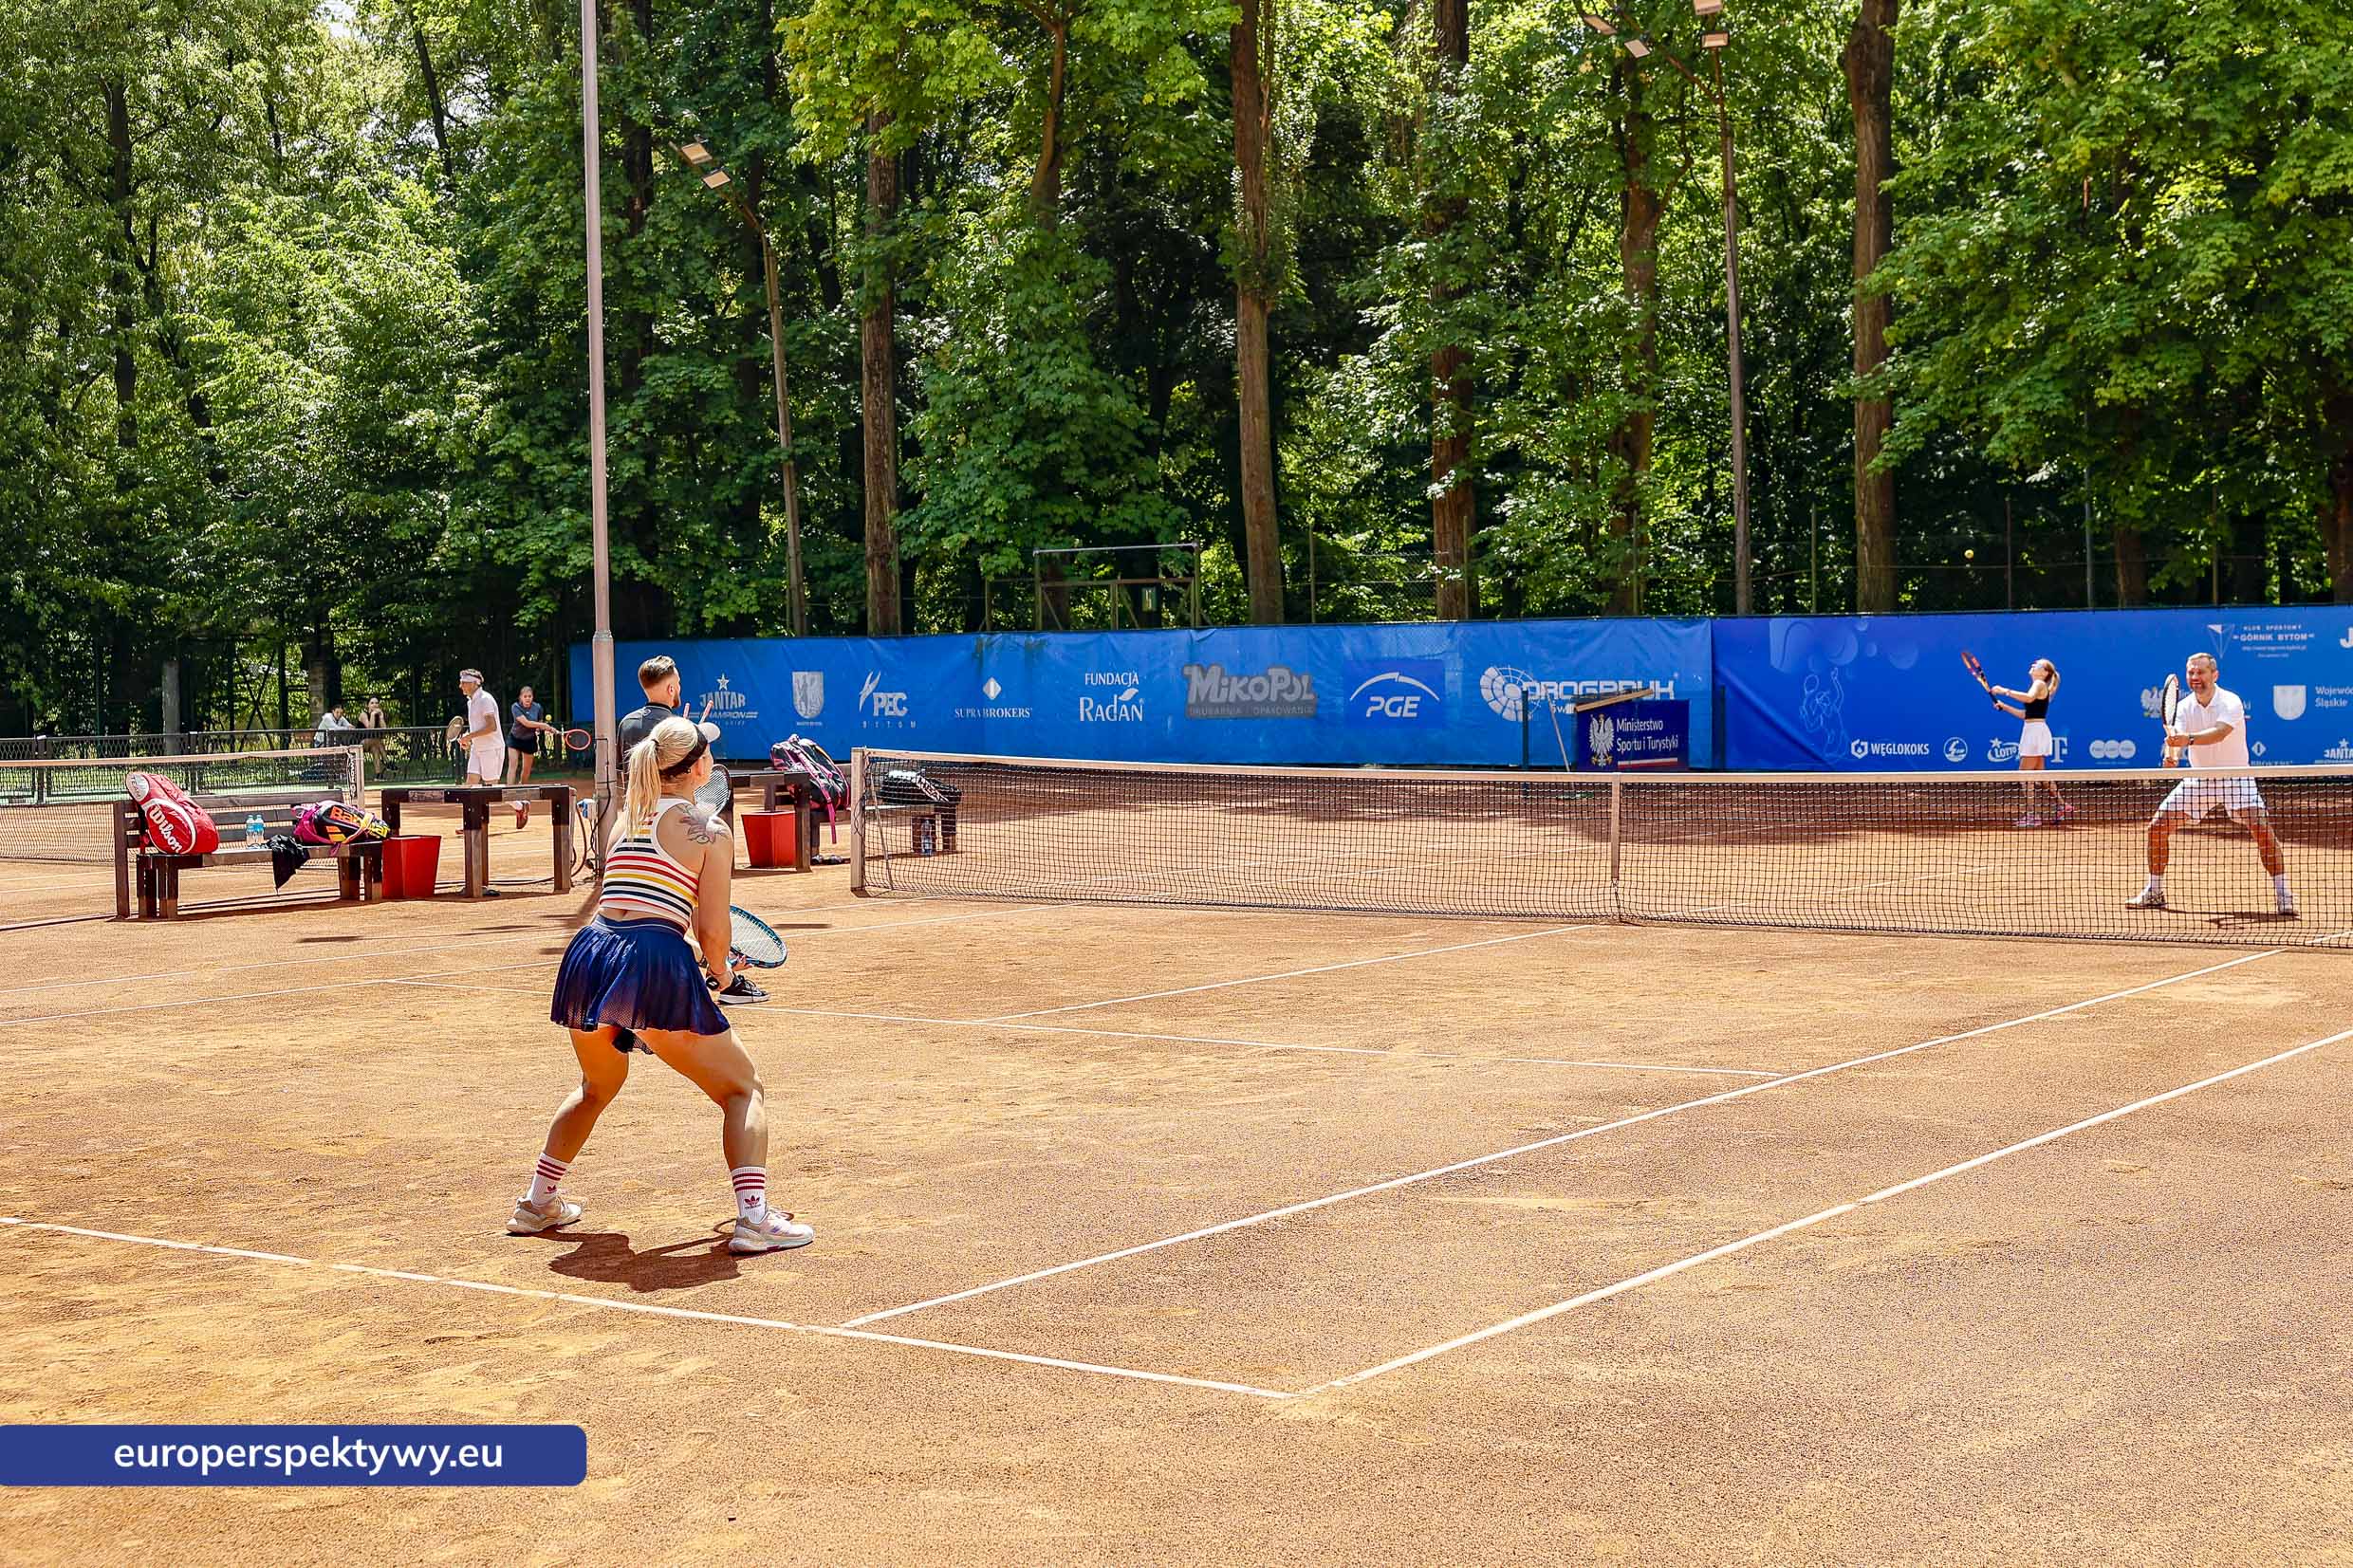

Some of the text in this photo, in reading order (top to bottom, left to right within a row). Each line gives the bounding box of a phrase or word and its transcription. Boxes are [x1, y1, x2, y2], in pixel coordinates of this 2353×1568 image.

[1084, 672, 1139, 687] FUNDACJA
[873, 692, 908, 716] PEC
[1366, 695, 1421, 718] PGE
[983, 707, 1030, 719] BROKERS
[1617, 718, 1663, 732] Ministerstwo
[1617, 737, 1641, 754] Sportu
[1647, 734, 1678, 754] Turystyki
[1870, 743, 1930, 756] WĘGLOKOKS
[149, 802, 183, 854] Wilson
